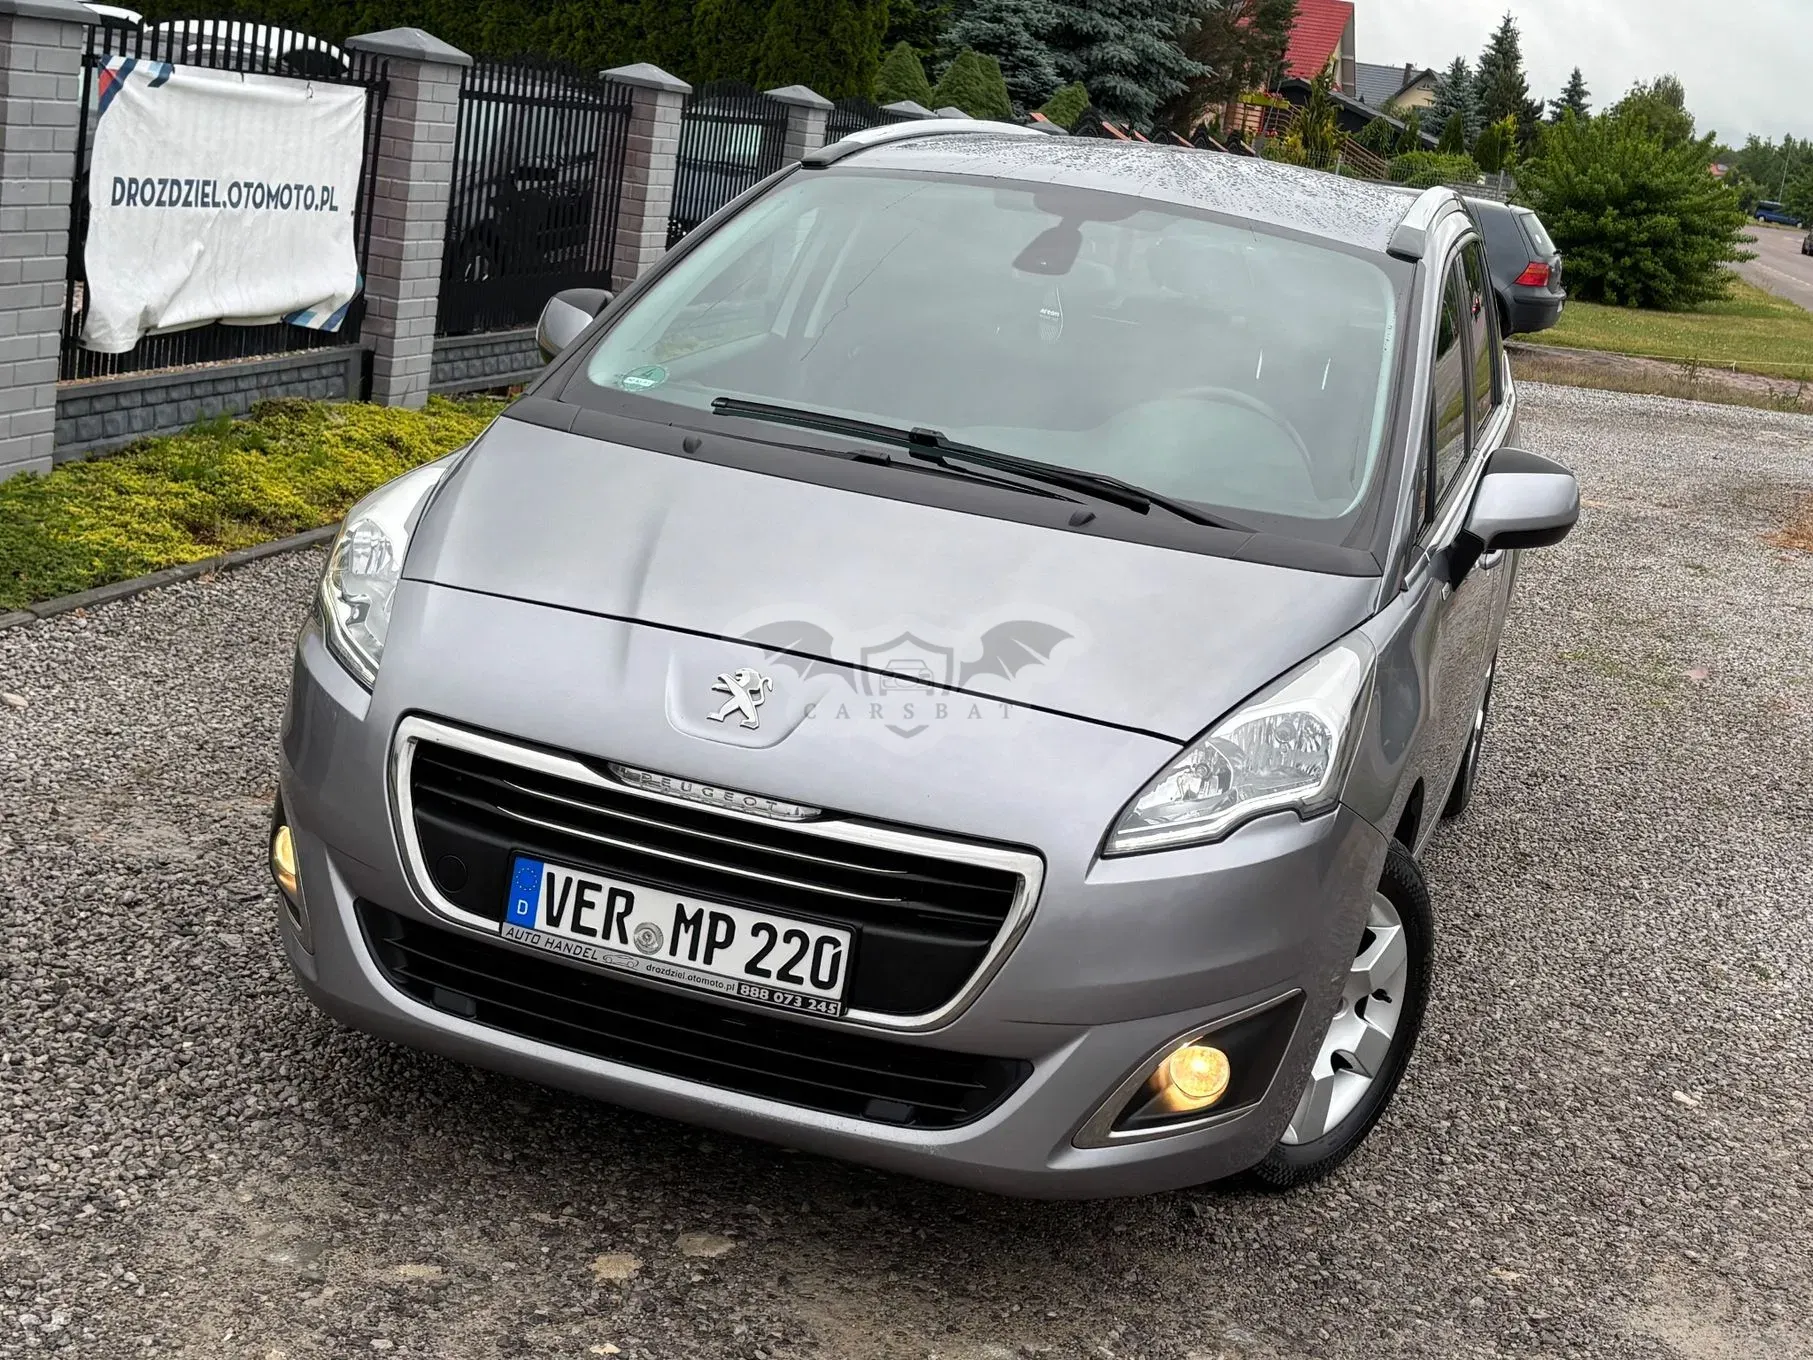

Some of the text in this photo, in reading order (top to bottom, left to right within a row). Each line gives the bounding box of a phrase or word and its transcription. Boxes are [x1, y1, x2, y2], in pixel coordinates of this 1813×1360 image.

[111, 176, 339, 212] DROZDZIEL.OTOMOTO.PL
[640, 772, 778, 811] PEUGEOT
[516, 871, 843, 991] D VER MP 220
[505, 927, 838, 1014] AUTO HANDEL drozdziel.otomoto.pl 888 073 245
